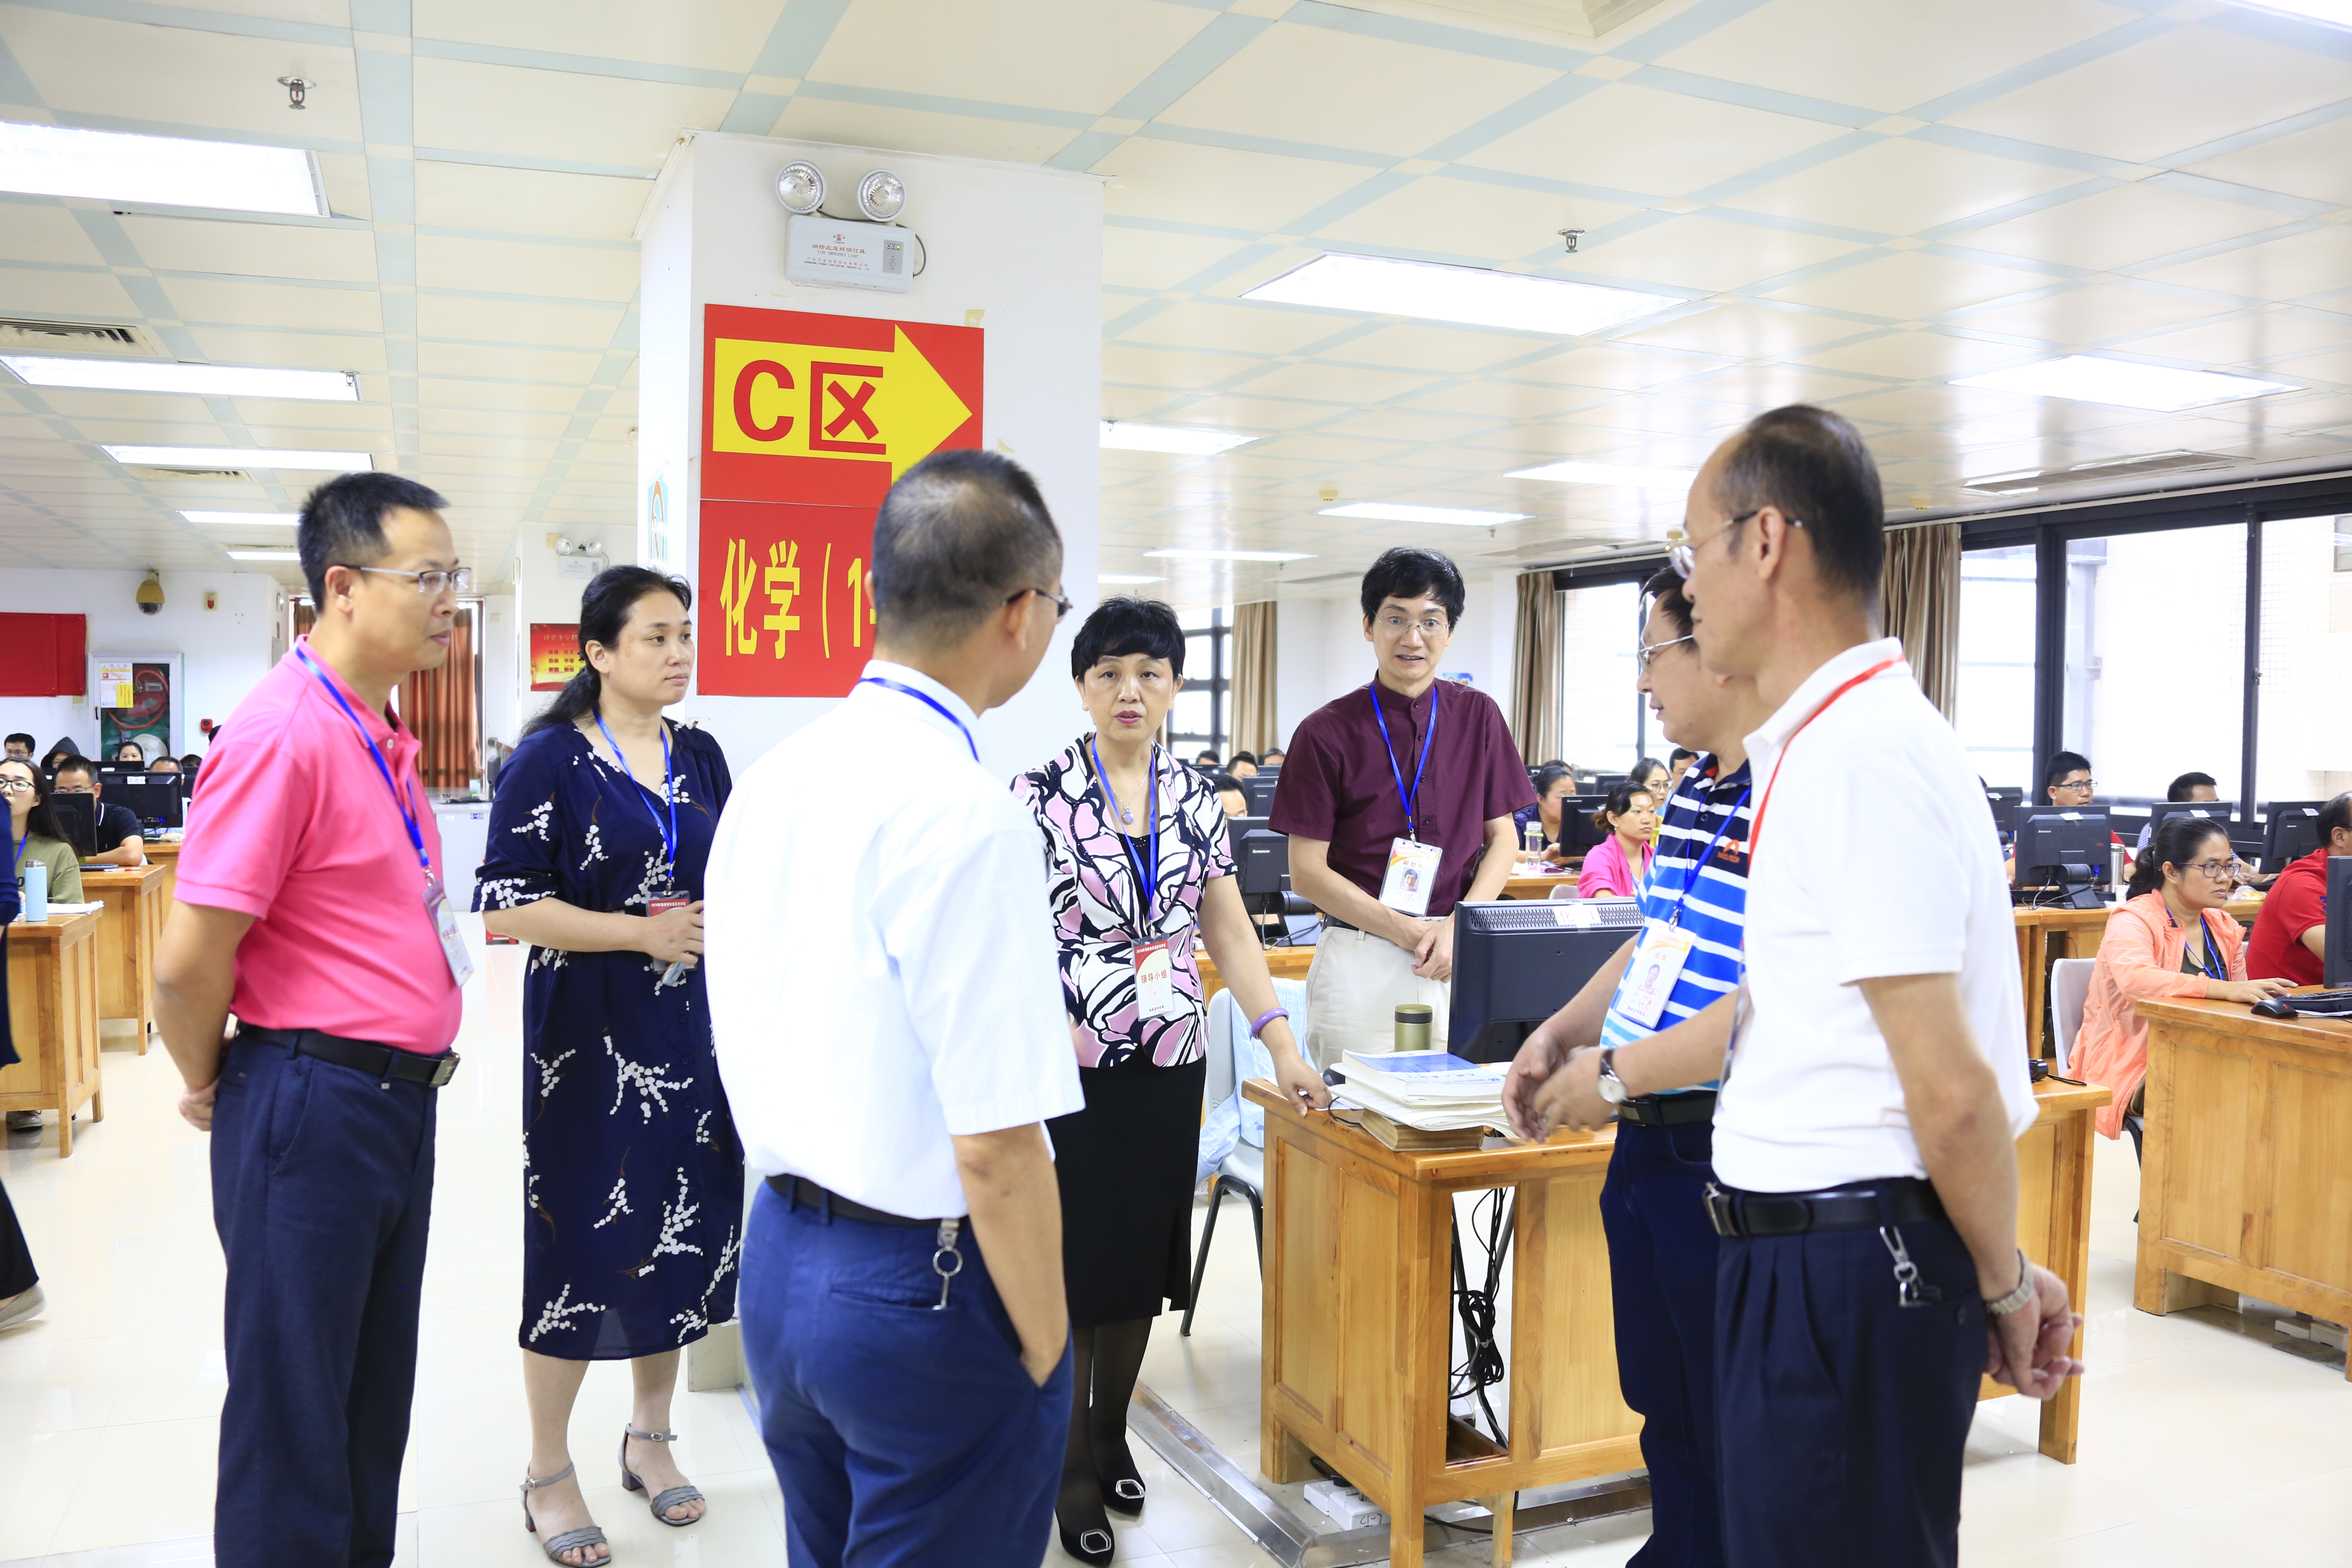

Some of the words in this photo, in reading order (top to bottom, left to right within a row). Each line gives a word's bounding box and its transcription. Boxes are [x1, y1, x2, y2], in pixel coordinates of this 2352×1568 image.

[812, 244, 866, 254] 消防应急照明灯具
[734, 360, 886, 454] C区
[1140, 969, 1167, 984] 领导小组
